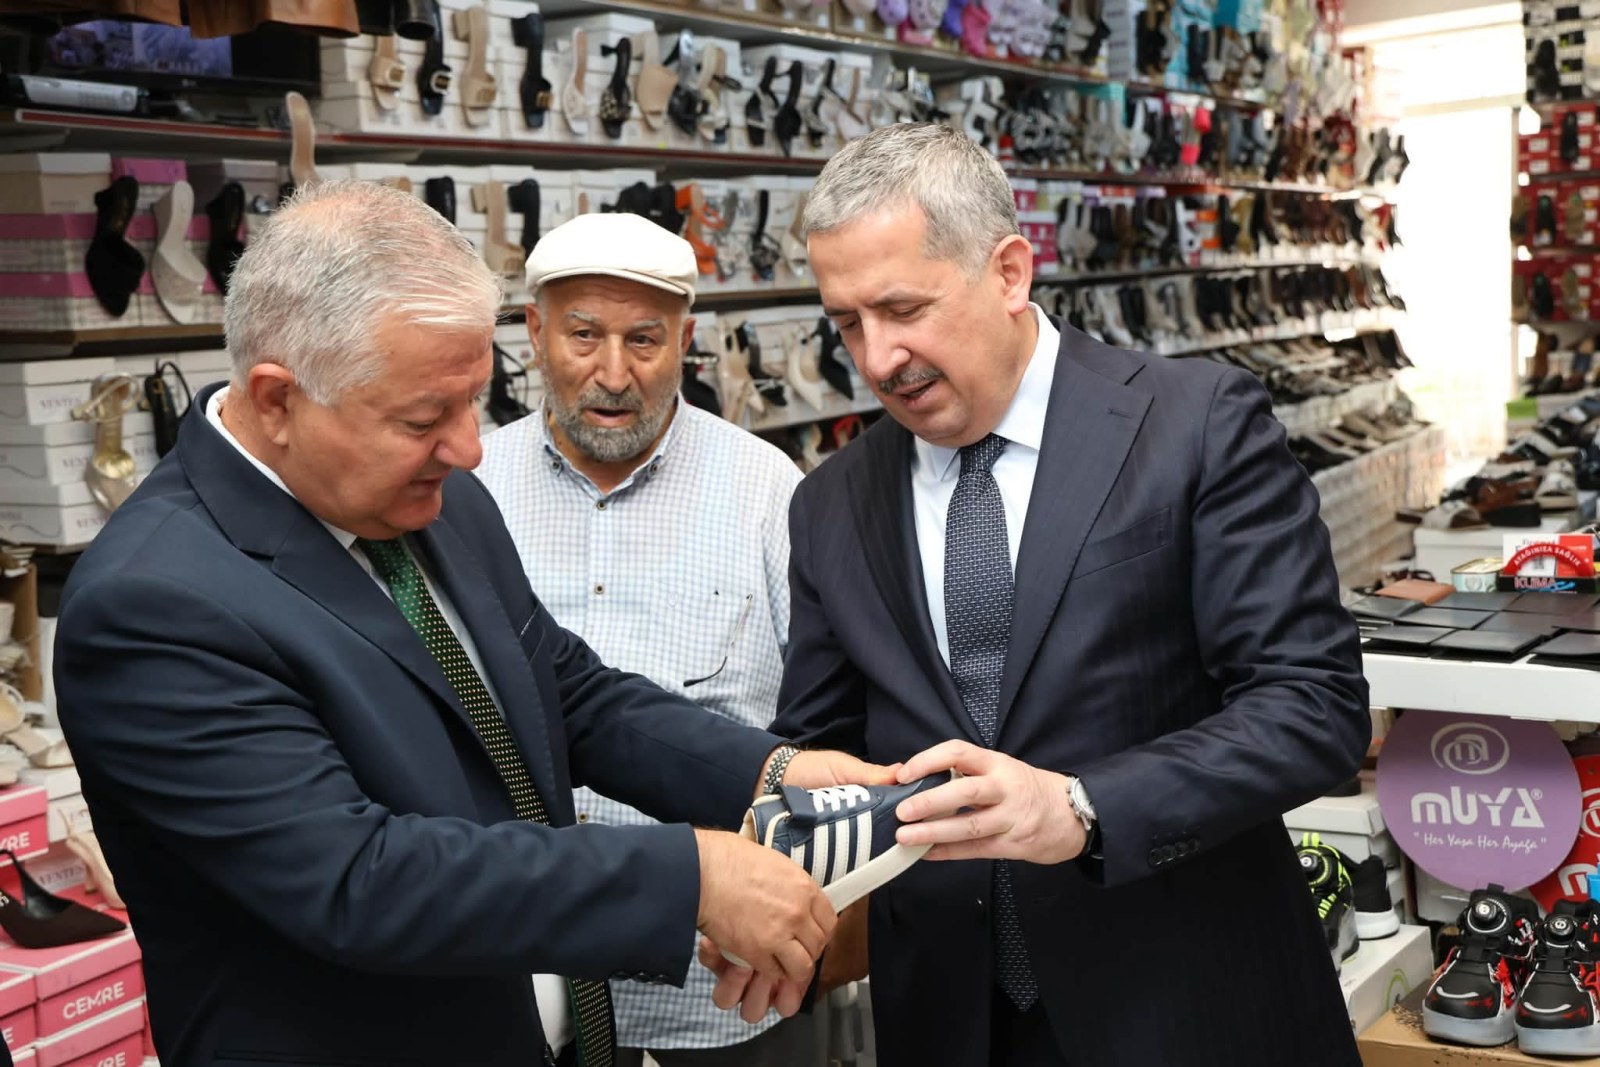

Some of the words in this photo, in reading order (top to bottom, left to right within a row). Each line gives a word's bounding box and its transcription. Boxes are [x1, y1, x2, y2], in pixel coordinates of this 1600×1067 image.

[1424, 832, 1444, 846] Her
[1477, 834, 1499, 849] Her
[63, 981, 125, 1020] CEMRE
